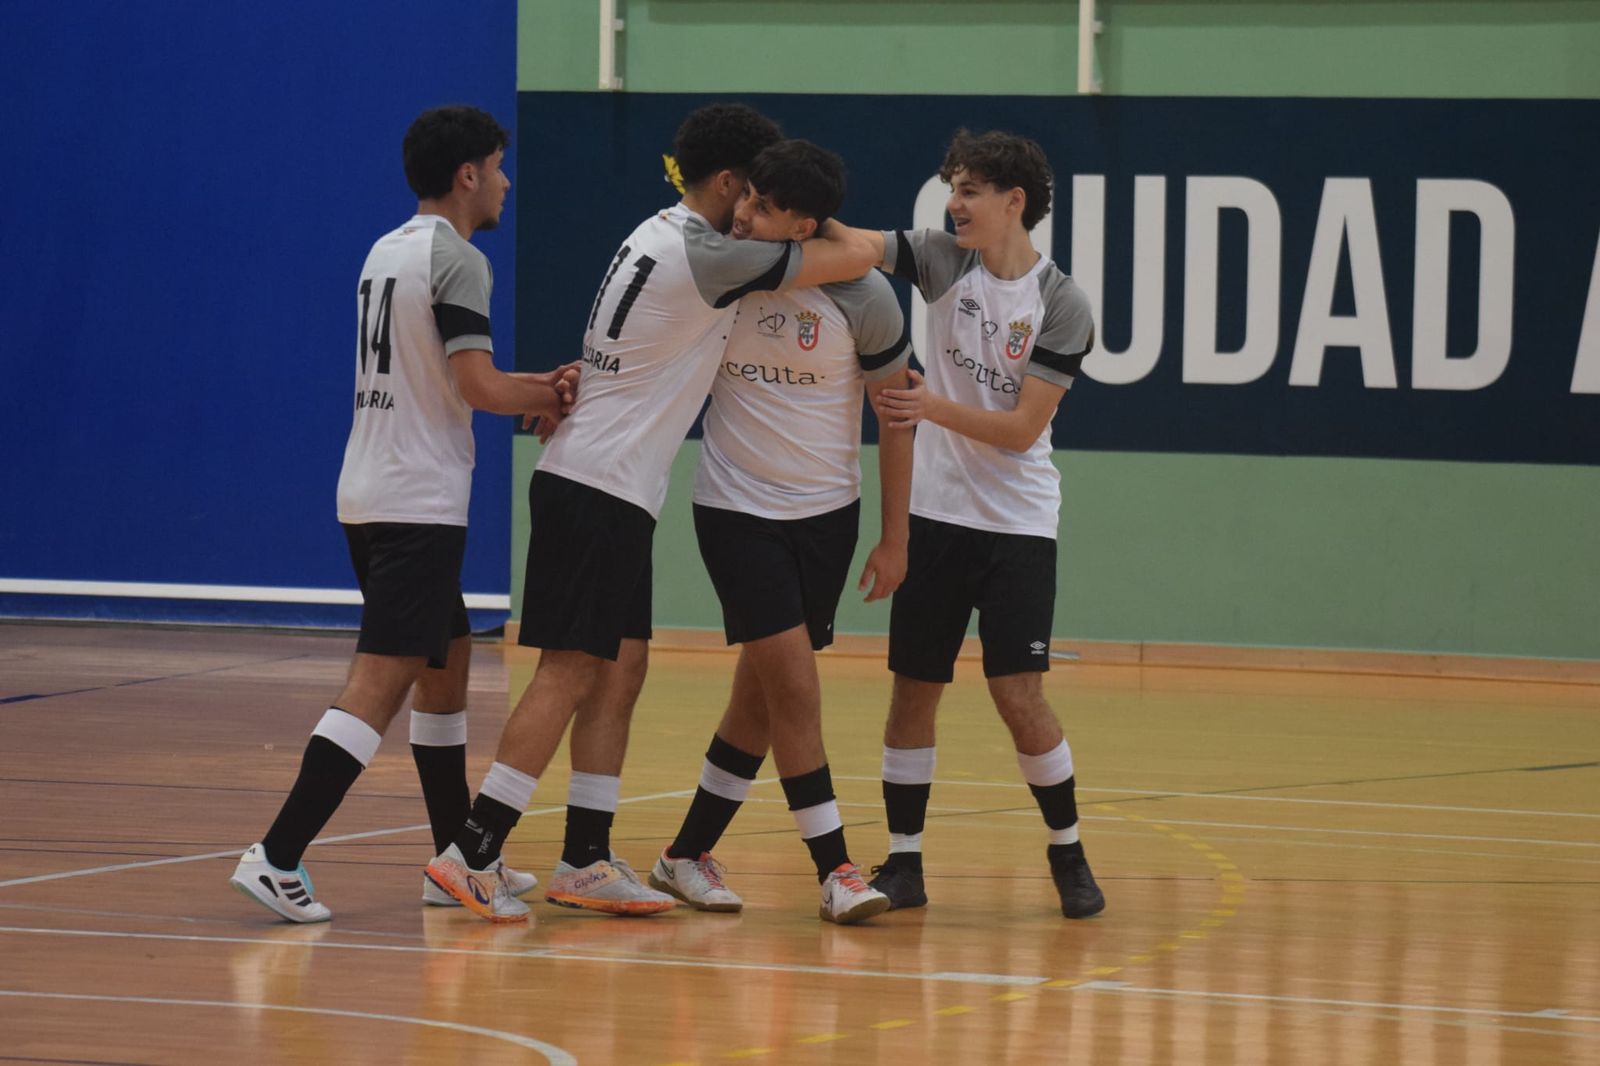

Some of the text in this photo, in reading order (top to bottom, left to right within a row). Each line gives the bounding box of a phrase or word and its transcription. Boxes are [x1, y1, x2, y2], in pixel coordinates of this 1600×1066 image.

[360, 277, 397, 375] 14
[590, 245, 657, 341] 11
[911, 174, 1515, 391] UDAD
